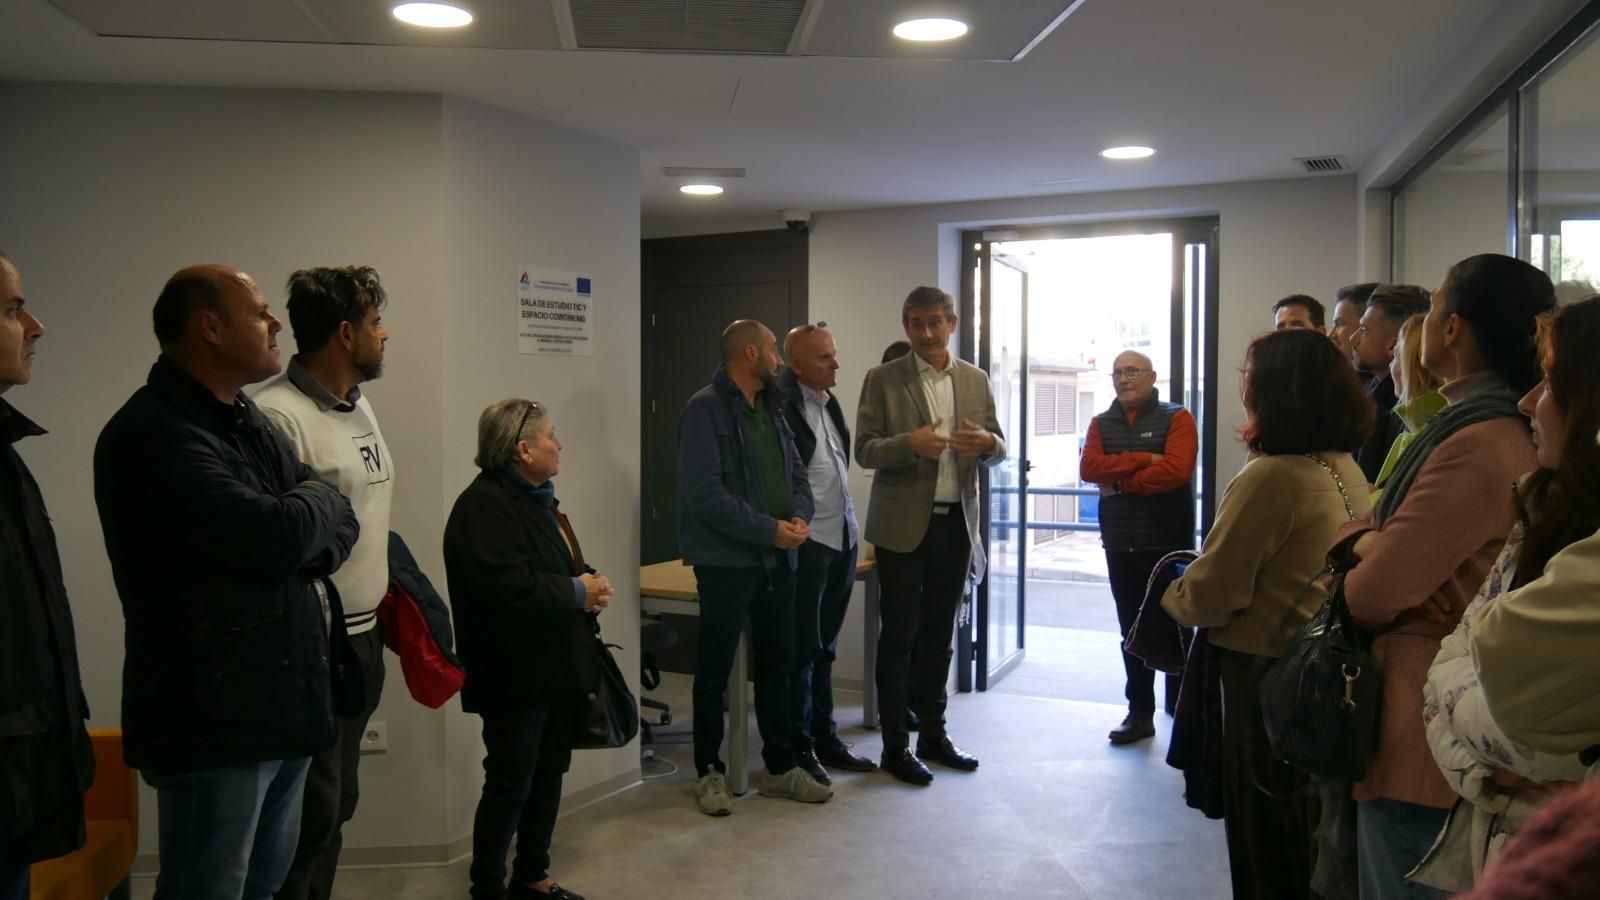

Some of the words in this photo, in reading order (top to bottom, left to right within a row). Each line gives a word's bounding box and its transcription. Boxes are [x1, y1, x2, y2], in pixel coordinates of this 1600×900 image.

[521, 298, 537, 306] SALA
[547, 301, 572, 310] ESTUDIO
[573, 303, 582, 311] TIC
[522, 311, 548, 319] ESPACIO
[549, 313, 585, 322] COWORKING
[360, 443, 381, 473] RV
